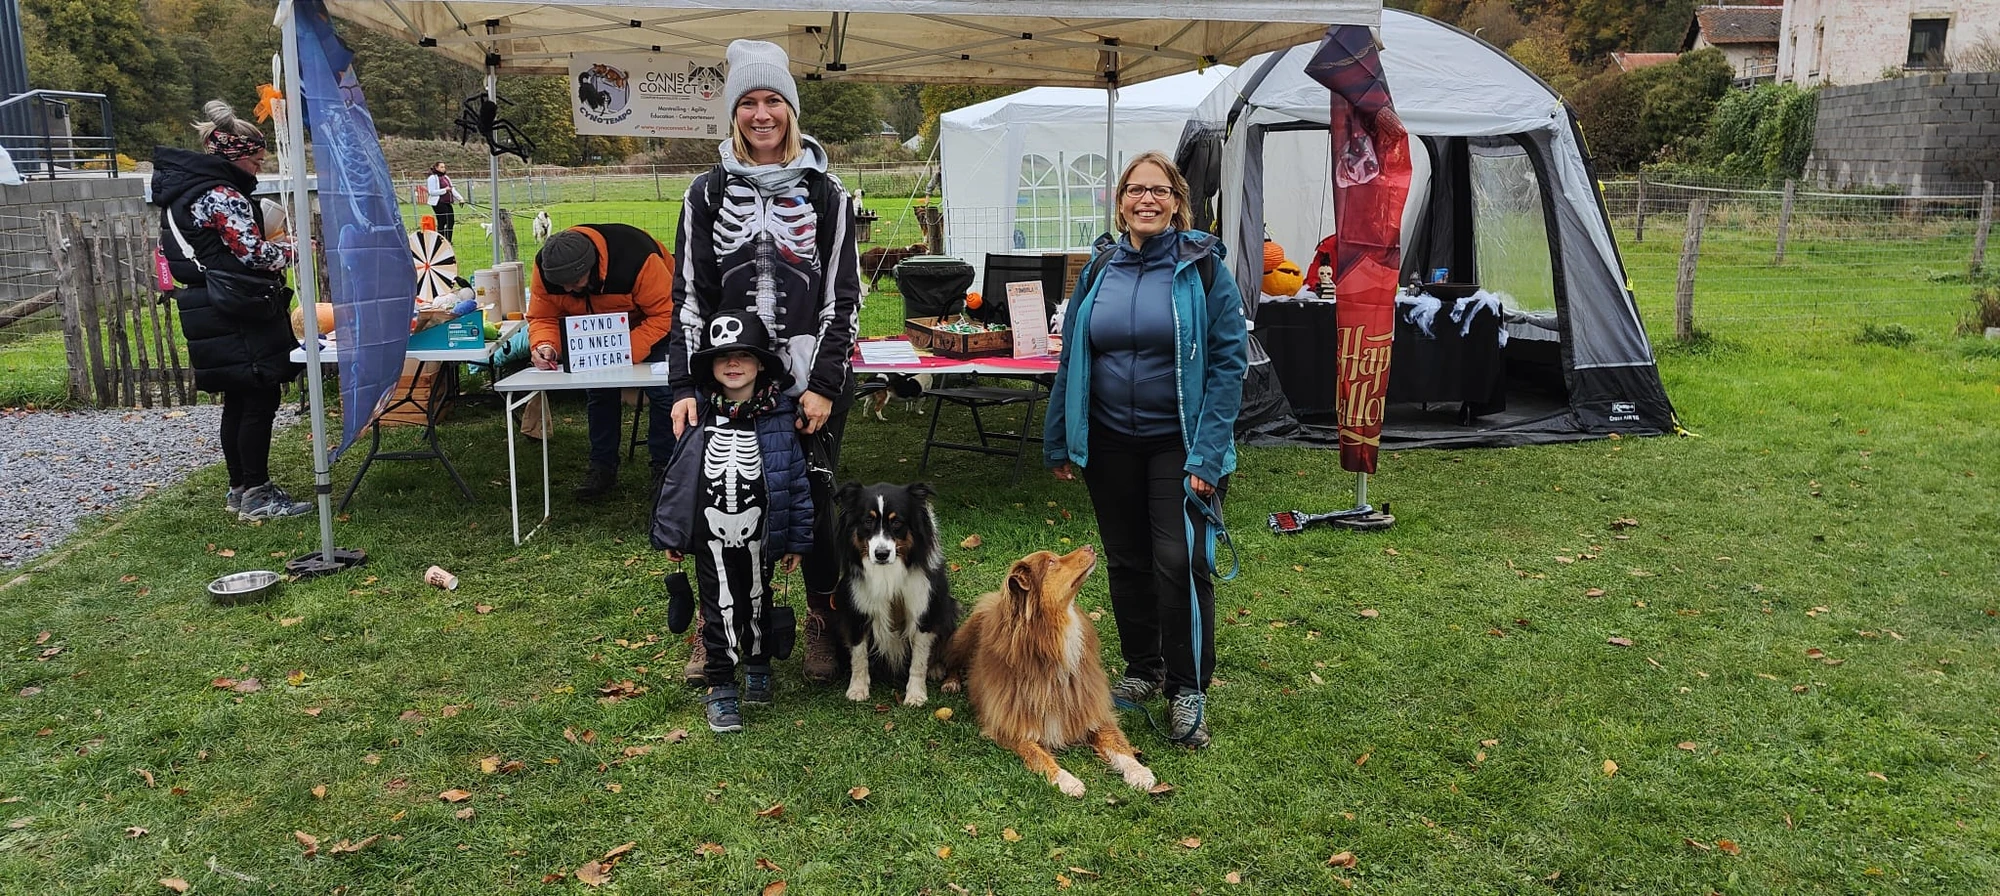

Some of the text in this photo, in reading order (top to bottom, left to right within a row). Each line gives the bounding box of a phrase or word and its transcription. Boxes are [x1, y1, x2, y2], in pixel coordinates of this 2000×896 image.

[645, 71, 685, 83] CANIS
[638, 82, 699, 95] CONNECT
[690, 106, 708, 114] Agility
[678, 113, 716, 121] Comportement
[582, 317, 612, 331] CYNO
[579, 352, 622, 368] #1YEAR
